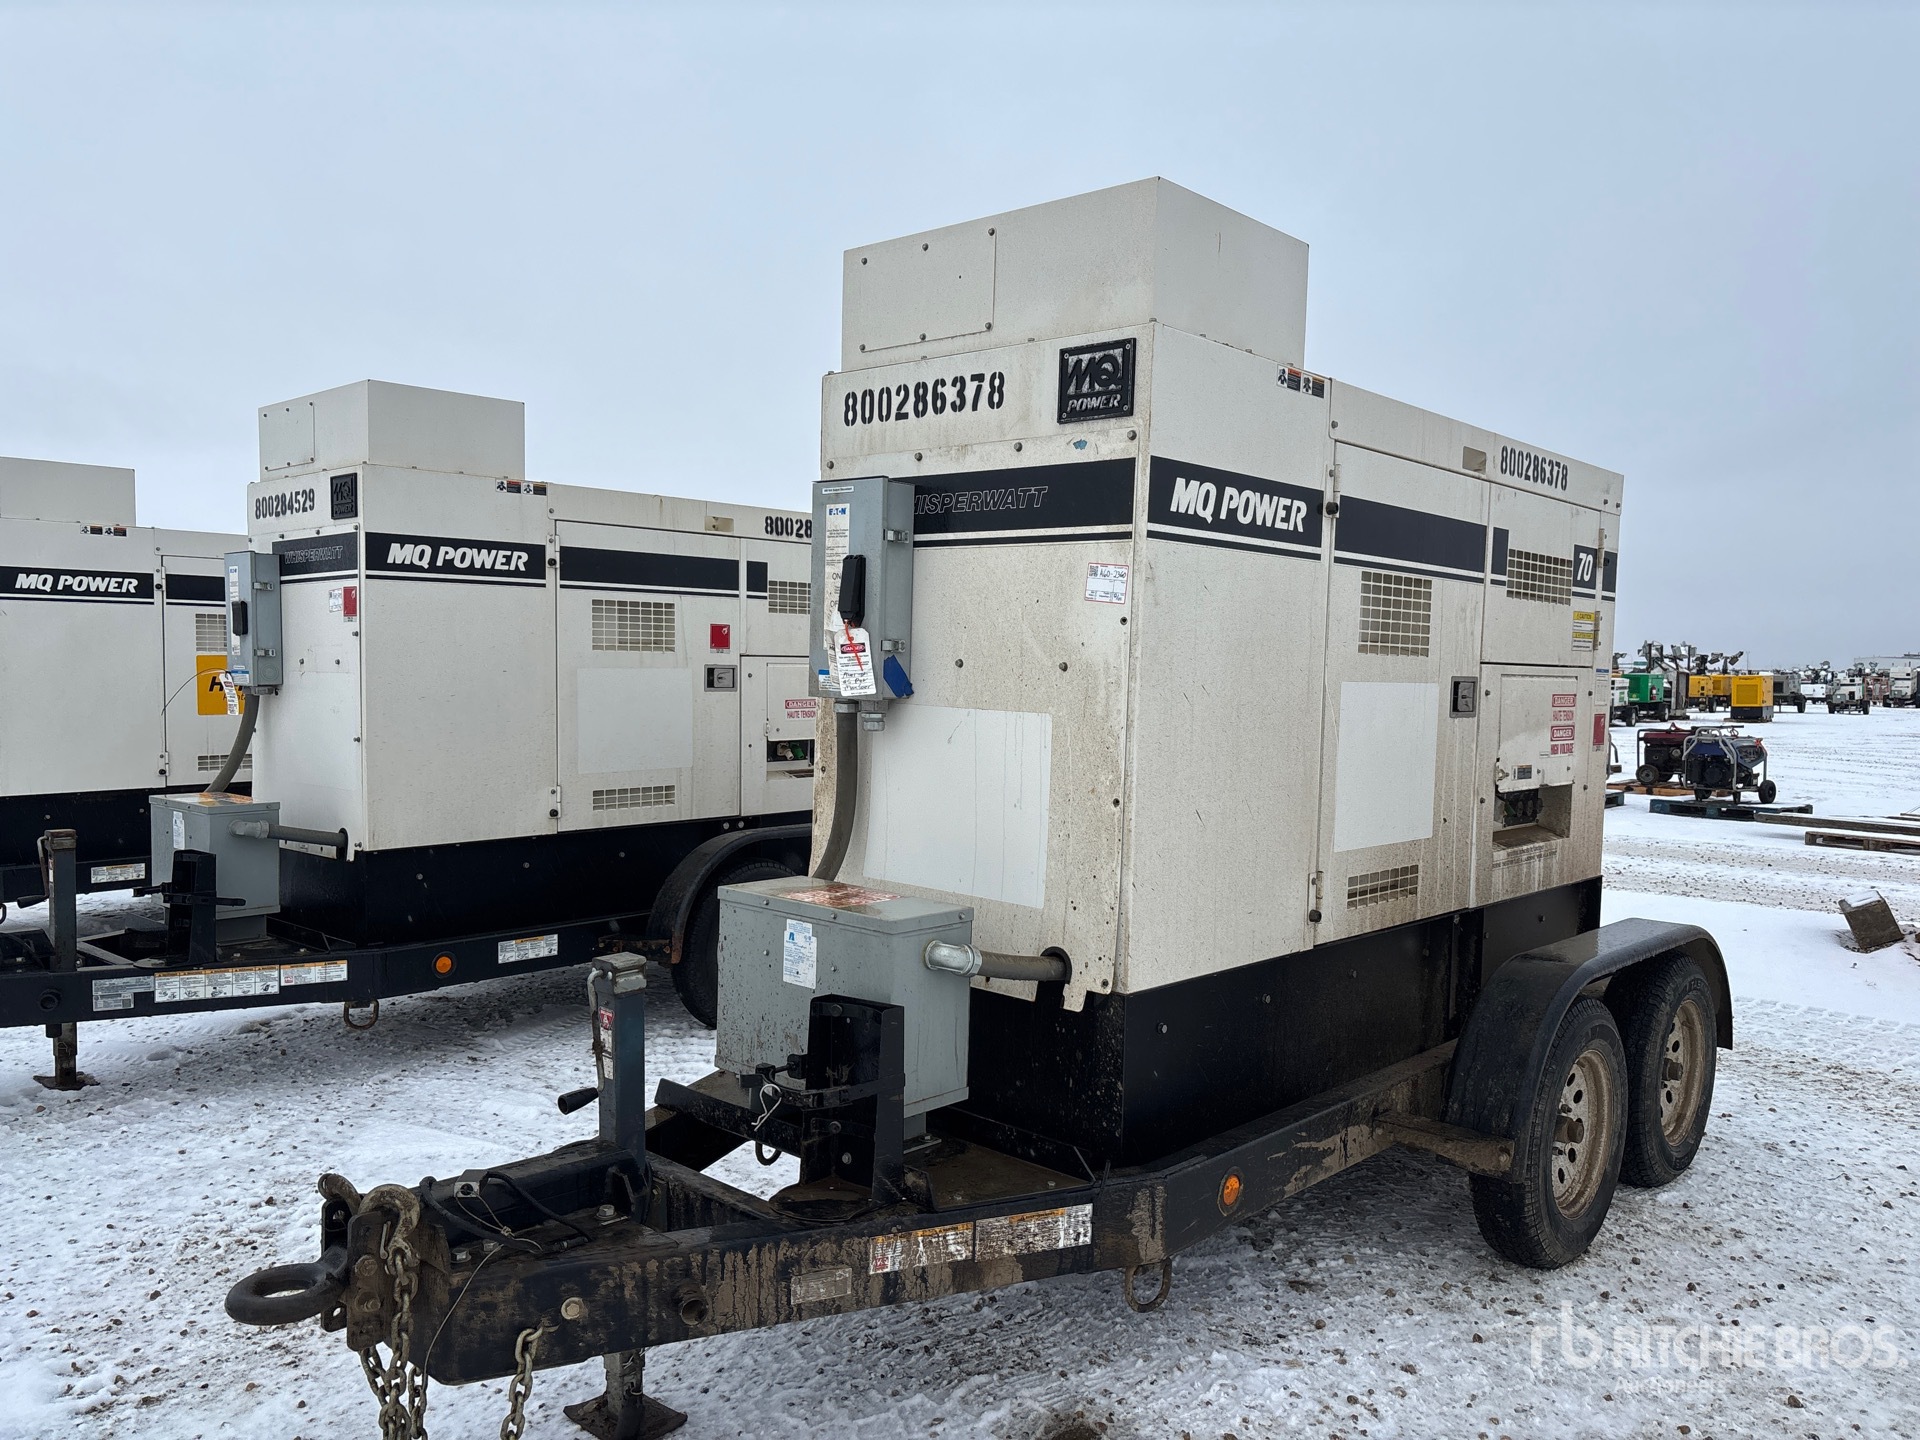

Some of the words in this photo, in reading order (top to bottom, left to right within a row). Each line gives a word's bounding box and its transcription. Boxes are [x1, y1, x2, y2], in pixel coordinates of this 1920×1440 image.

[1066, 353, 1122, 393] MQ
[843, 371, 1005, 427] 800286378
[1067, 394, 1121, 413] POWER
[1500, 445, 1569, 491] 800286378
[255, 488, 315, 519] 800284529
[914, 486, 1048, 514] ISPERWATT
[1170, 477, 1217, 524] MQ
[1219, 486, 1308, 532] POWER
[764, 515, 813, 539] 80028
[284, 546, 343, 564] WHISPERWATT
[386, 542, 432, 569] MQ
[436, 546, 529, 571] POWER
[1576, 552, 1594, 582] 70
[15, 573, 54, 592] MQ
[57, 575, 138, 593] POWER
[1553, 729, 1572, 738] DANGER
